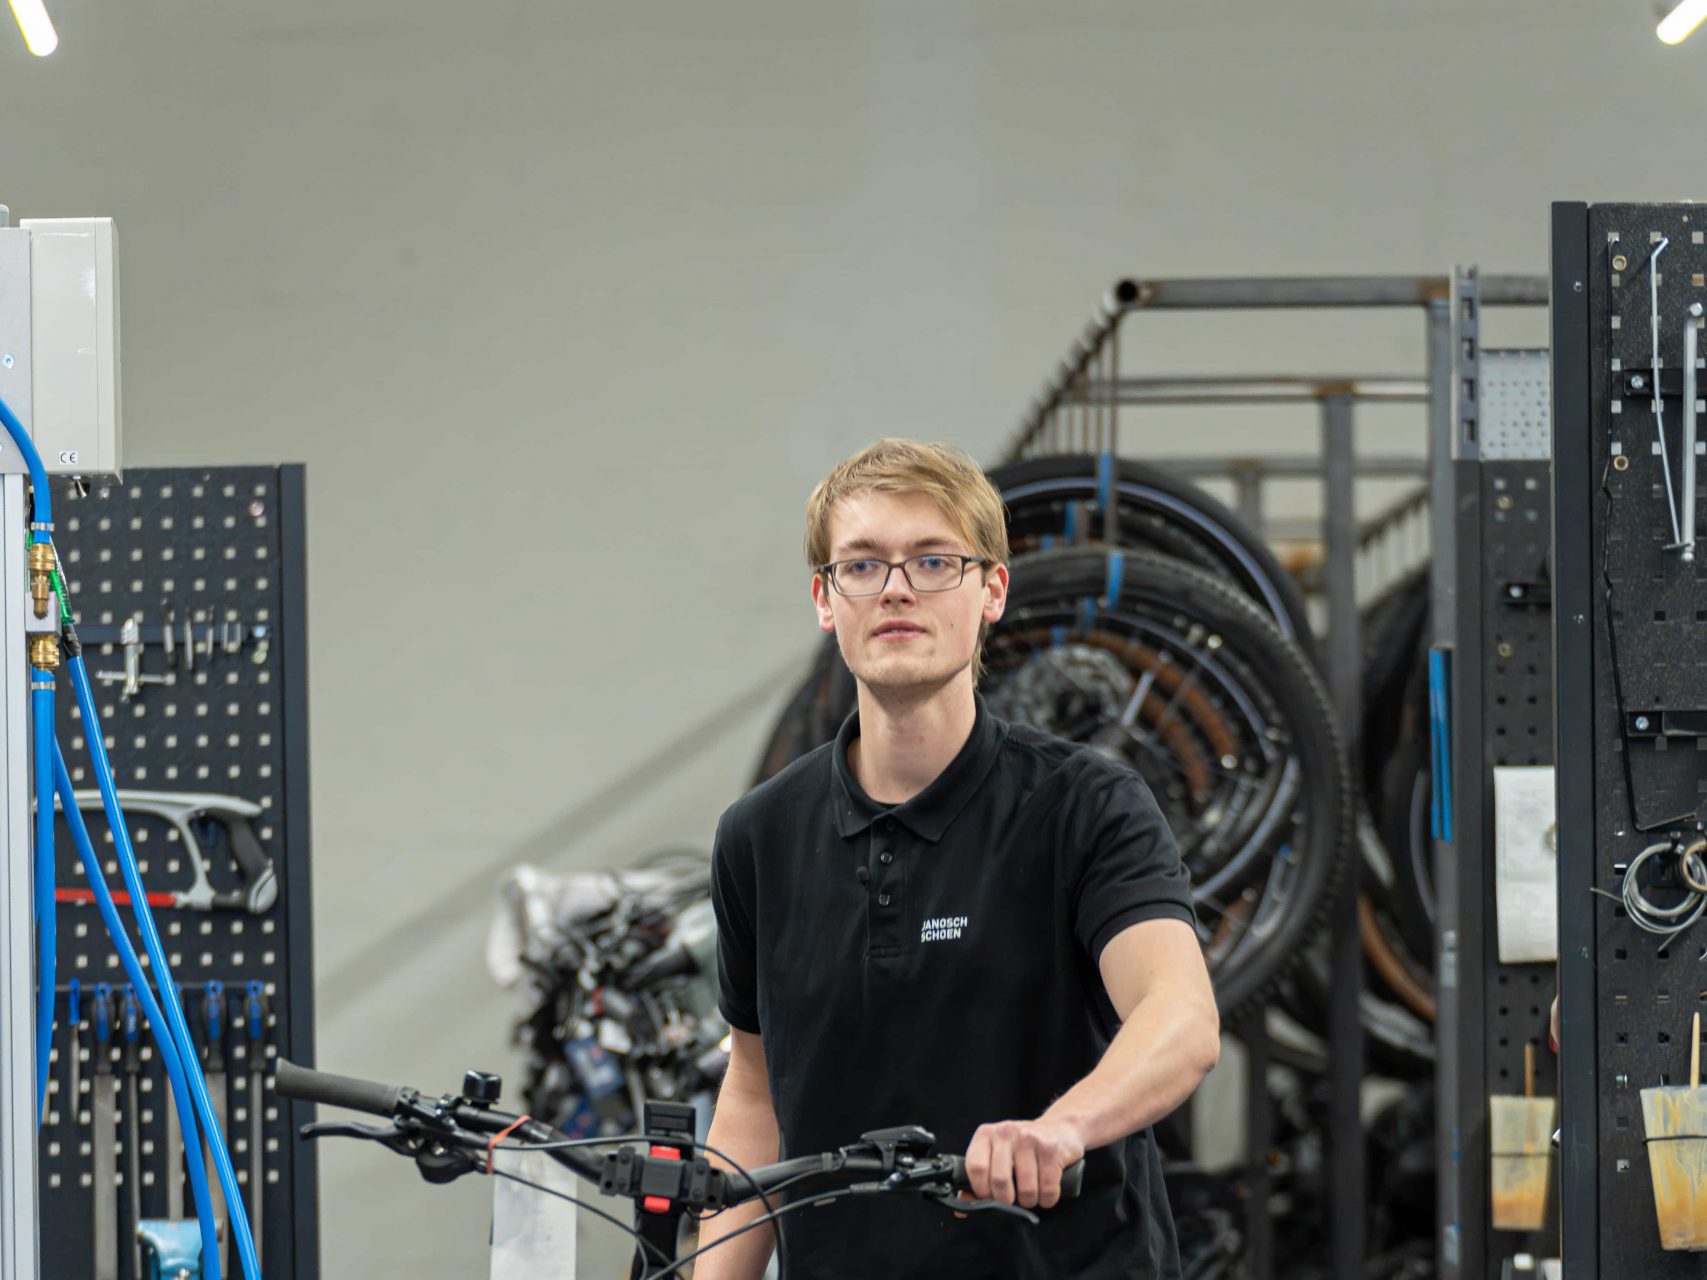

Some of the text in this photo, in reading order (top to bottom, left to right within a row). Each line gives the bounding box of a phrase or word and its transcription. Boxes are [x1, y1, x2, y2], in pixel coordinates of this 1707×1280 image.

[60, 452, 76, 464] CE
[921, 916, 968, 931] JANOSCH
[921, 928, 961, 943] SCHOEN
